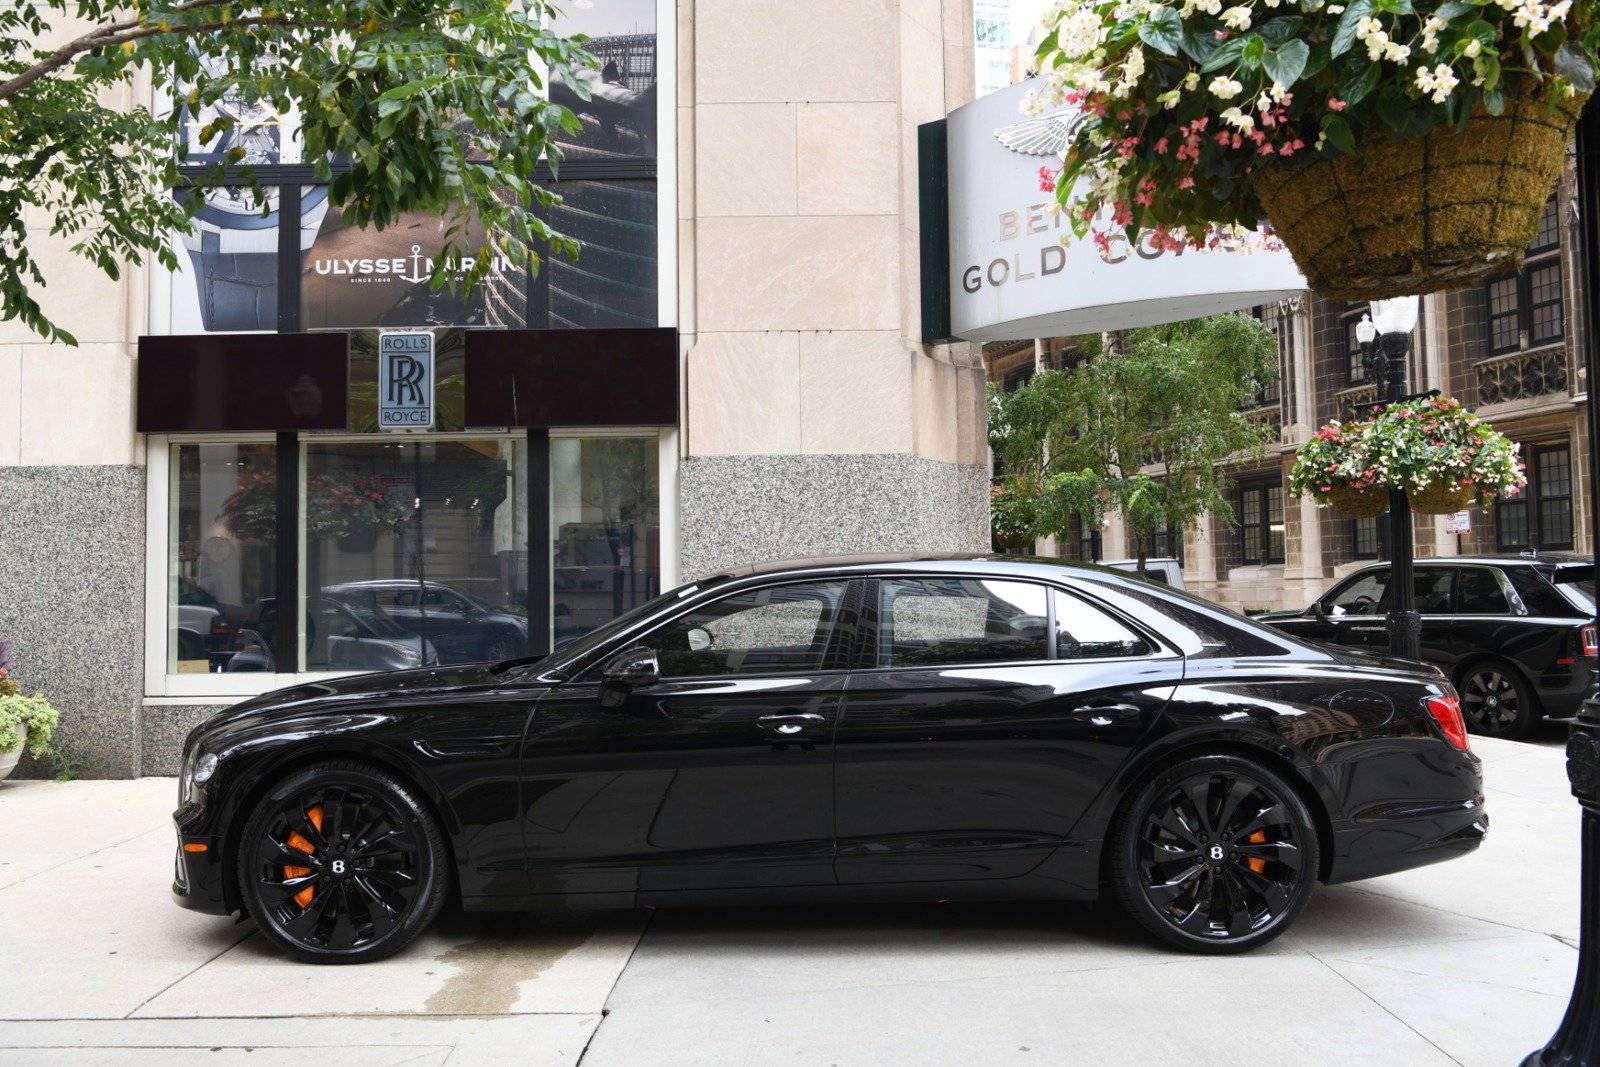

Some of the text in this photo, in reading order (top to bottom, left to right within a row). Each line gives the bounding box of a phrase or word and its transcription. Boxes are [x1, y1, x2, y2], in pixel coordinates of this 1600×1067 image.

[315, 259, 406, 275] ULYSSE
[962, 245, 1067, 293] GOLD
[384, 338, 428, 350] ROLLS
[384, 411, 427, 422] ROYCE
[1210, 846, 1224, 860] B
[332, 860, 345, 873] B
